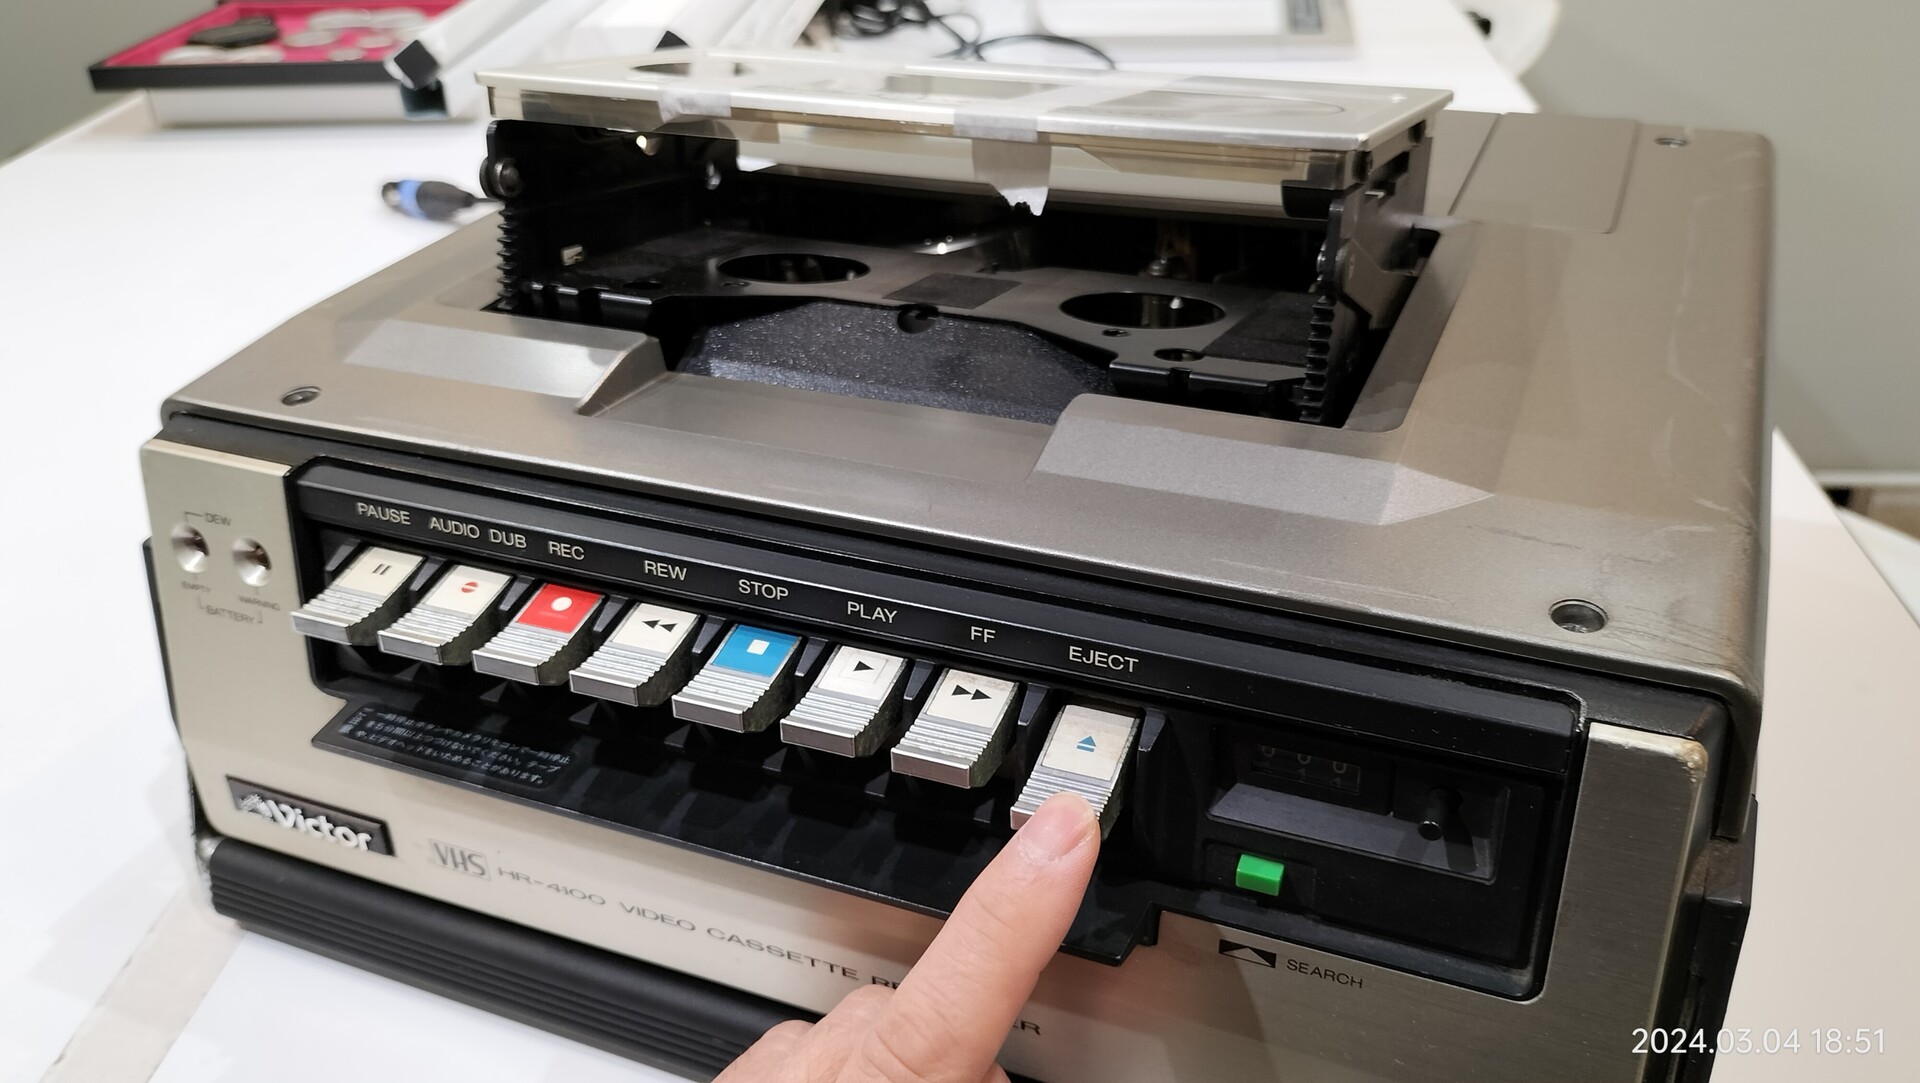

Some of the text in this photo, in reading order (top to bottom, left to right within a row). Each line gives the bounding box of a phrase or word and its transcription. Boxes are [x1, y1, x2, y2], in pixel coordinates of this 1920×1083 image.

[204, 512, 232, 526] DEW
[356, 502, 411, 525] PAUSE
[429, 517, 527, 548] AUDIO DUB
[548, 541, 585, 560] REC
[643, 560, 687, 581] REW
[738, 579, 789, 601] STOP
[205, 605, 255, 623] BATTERY
[847, 601, 898, 624] PLAY
[971, 625, 996, 644] FF
[1068, 645, 1139, 673] EJECT
[265, 799, 372, 851] Victor
[432, 842, 486, 876] VHS
[499, 867, 859, 980] HR-4100 VIDEO CASSETTE
[1286, 958, 1363, 989] SEARCH
